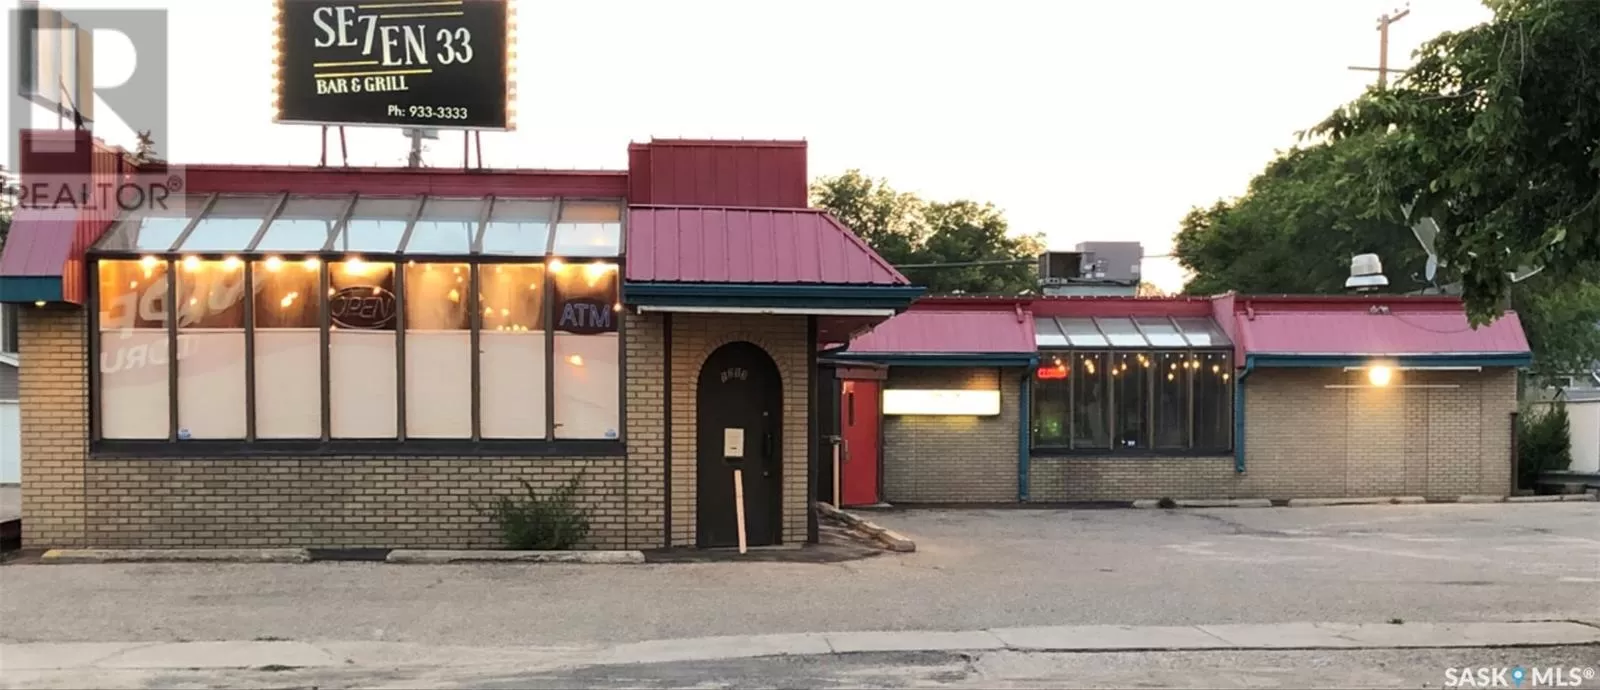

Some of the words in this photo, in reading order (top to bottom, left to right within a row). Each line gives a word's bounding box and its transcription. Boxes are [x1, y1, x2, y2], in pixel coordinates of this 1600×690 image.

[313, 6, 428, 66] SE7EN
[436, 27, 473, 65] 33
[316, 77, 348, 94] BAR
[351, 78, 361, 93] &
[364, 75, 408, 91] GRILL
[388, 105, 406, 118] Ph:
[409, 106, 468, 119] 933-3333
[331, 296, 393, 318] OPEN
[559, 303, 611, 328] ATM
